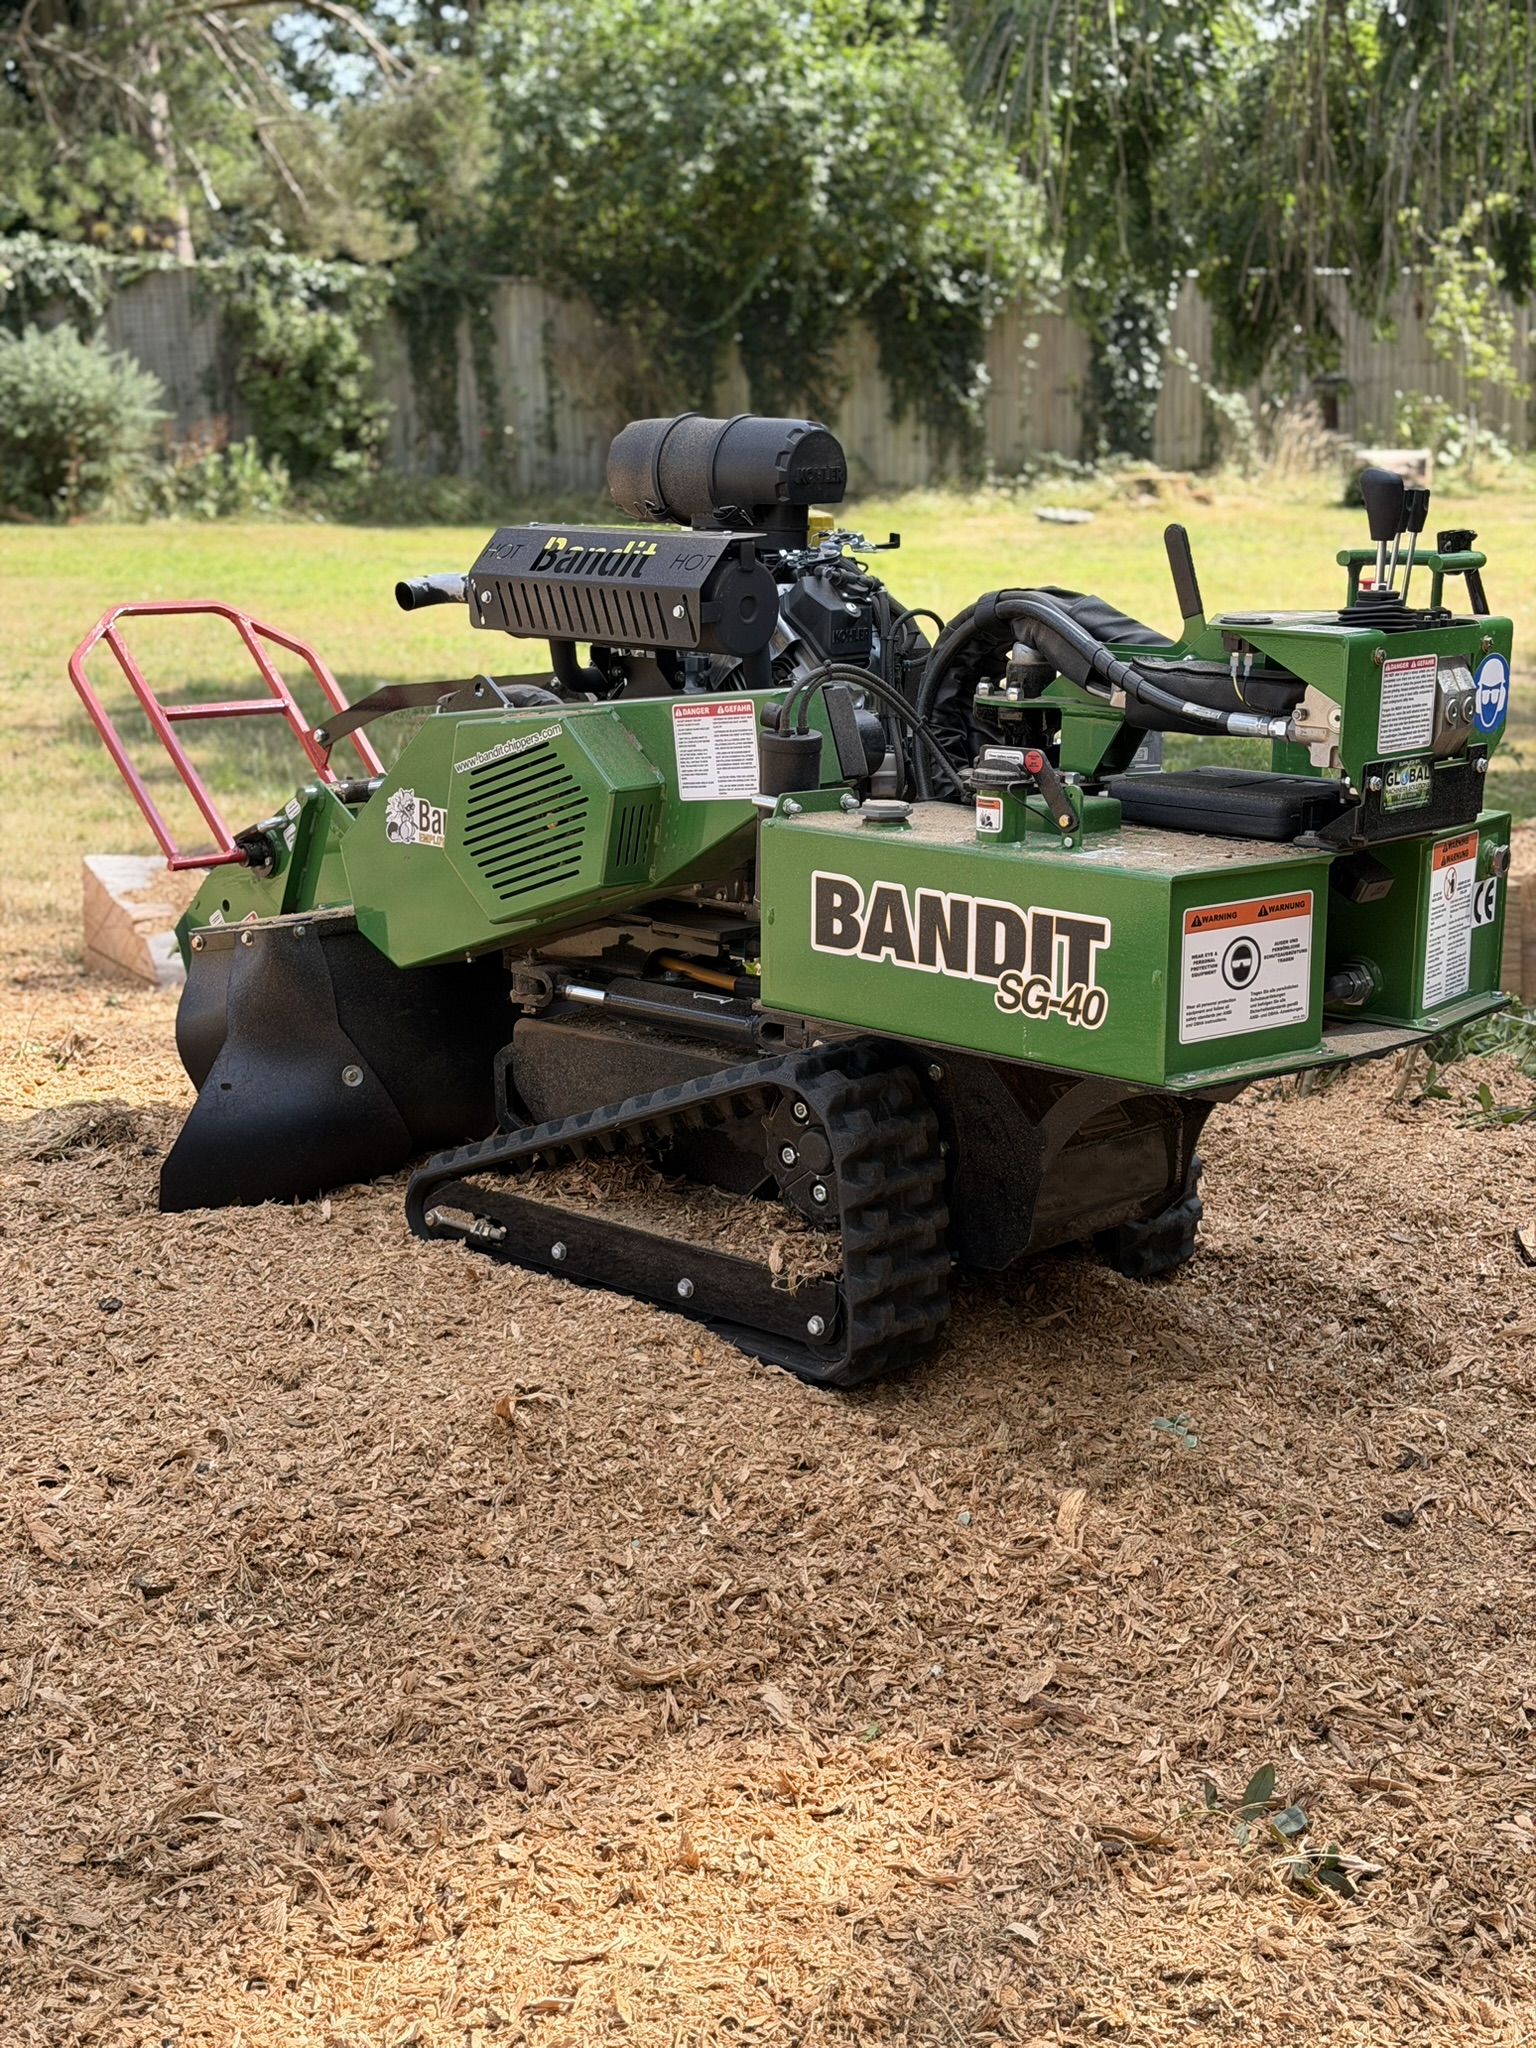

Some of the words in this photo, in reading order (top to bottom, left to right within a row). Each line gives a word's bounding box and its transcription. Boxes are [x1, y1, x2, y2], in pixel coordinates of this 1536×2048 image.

[795, 466, 842, 485] KOHLER
[482, 542, 525, 560] HOT
[529, 536, 658, 578] Bandit
[669, 554, 716, 571] HOT
[832, 628, 869, 644] KOHLER
[1390, 661, 1410, 669] DANGER
[1416, 658, 1435, 667] GEFAHR
[682, 706, 710, 716] DANGER
[724, 704, 752, 713] GEFAHR
[455, 726, 562, 772] www.banditchippers.com
[1386, 765, 1430, 787] GLOBAL
[1474, 879, 1494, 924] CE
[1201, 911, 1238, 924] WARNING
[1268, 900, 1306, 913] WARNUNG
[813, 875, 1107, 987] BANDIT
[1191, 952, 1204, 960] WEAR
[1193, 957, 1216, 965] PERSONAL
[1190, 963, 1218, 972] PROTECTION
[1191, 969, 1217, 978] EQUIPMENT
[996, 972, 1107, 1027] SG-40
